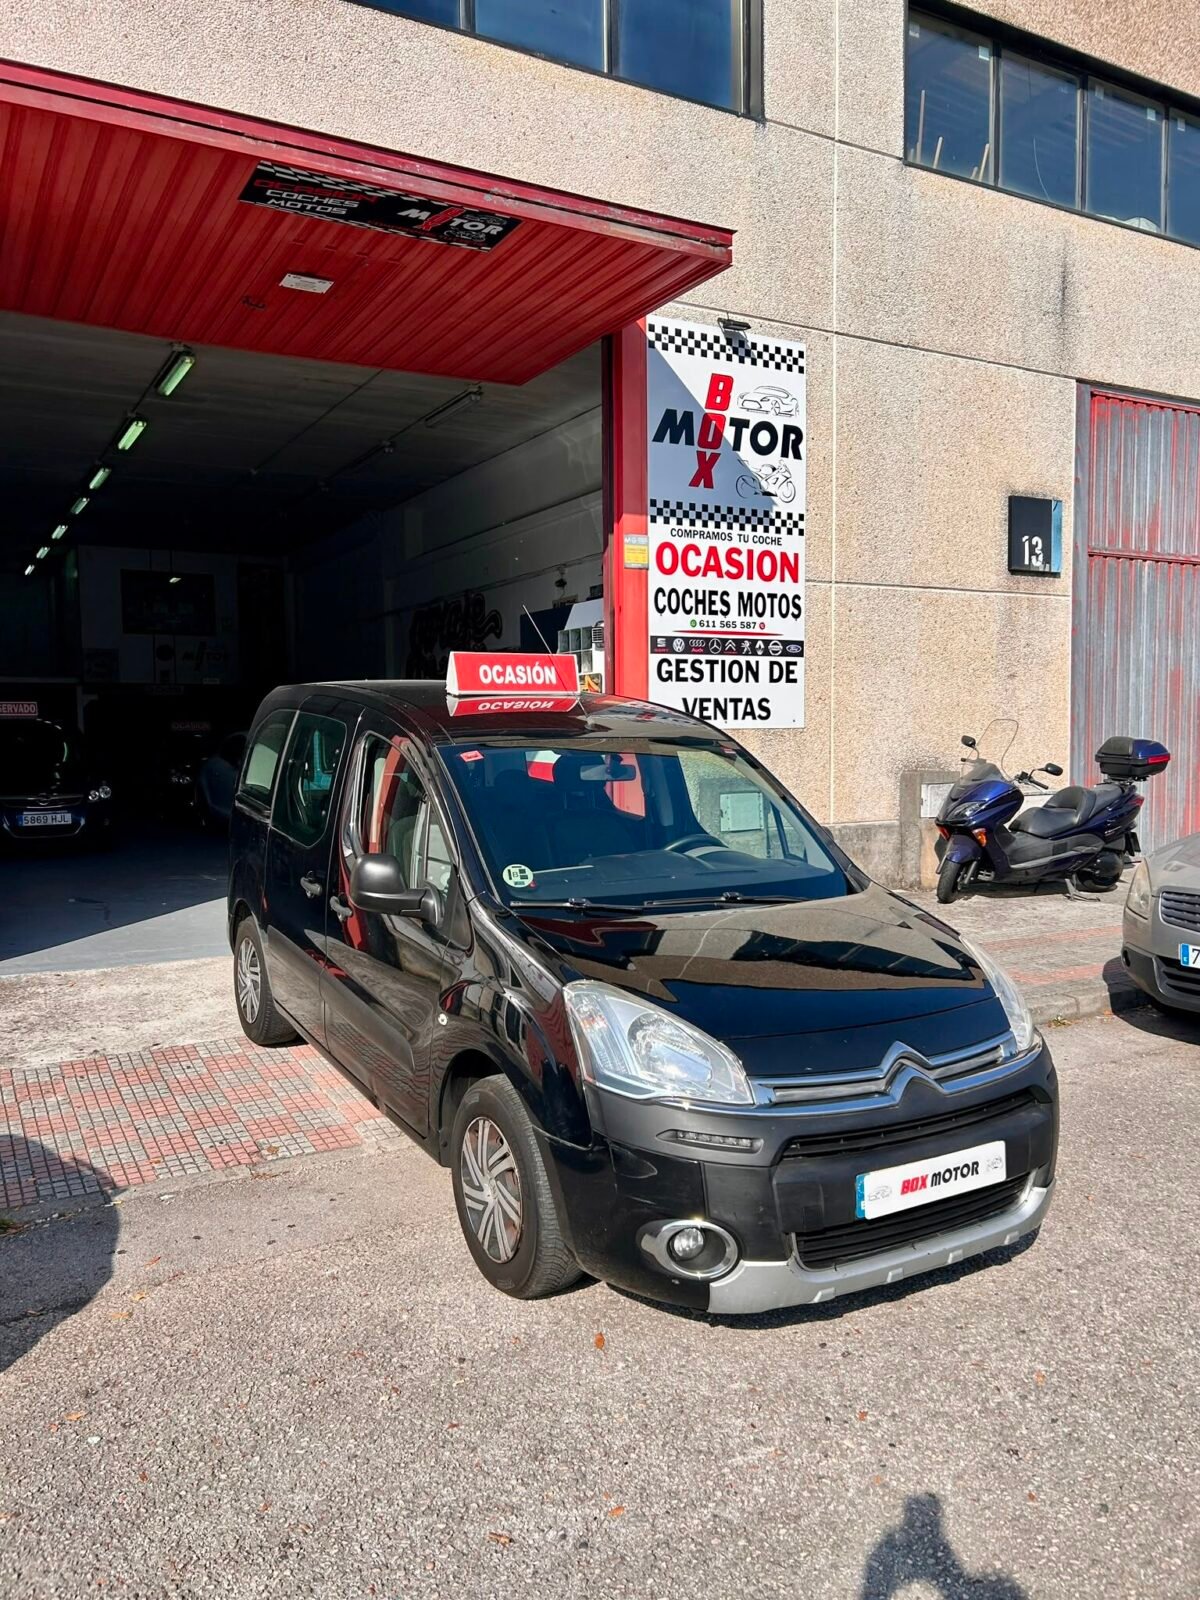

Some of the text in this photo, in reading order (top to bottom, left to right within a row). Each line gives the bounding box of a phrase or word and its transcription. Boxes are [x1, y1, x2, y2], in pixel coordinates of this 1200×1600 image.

[265, 189, 360, 208] COCHES
[267, 198, 348, 215] MOTOS
[670, 528, 782, 546] COMPRAMOS TU COCHE
[655, 541, 799, 583] OCASION
[1022, 535, 1043, 567] 13
[654, 586, 802, 619] COCHES MOTOS
[699, 619, 757, 629] 611 565 587
[478, 662, 557, 685] OCASIÓN
[656, 657, 798, 684] GESTION DE
[682, 697, 771, 721] VENTAS
[24, 815, 48, 825] 5869
[900, 1161, 980, 1196] BOX MOTOR
